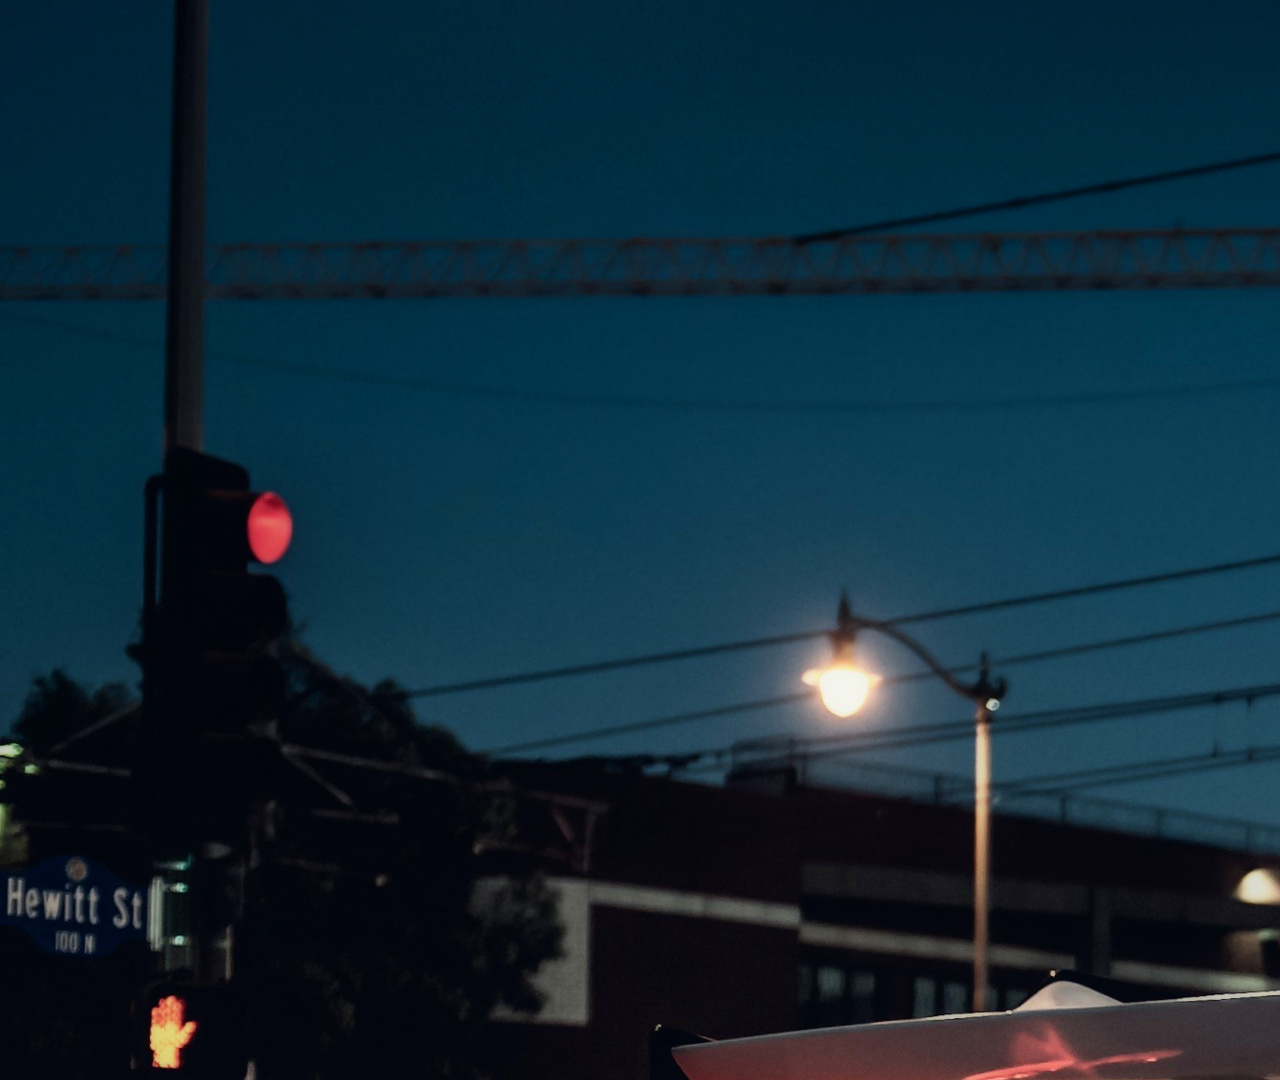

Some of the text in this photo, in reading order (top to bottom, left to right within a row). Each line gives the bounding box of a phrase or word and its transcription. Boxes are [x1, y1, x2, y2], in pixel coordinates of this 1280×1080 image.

[7, 877, 142, 930] Hewitt St
[55, 931, 96, 954] 100 N
